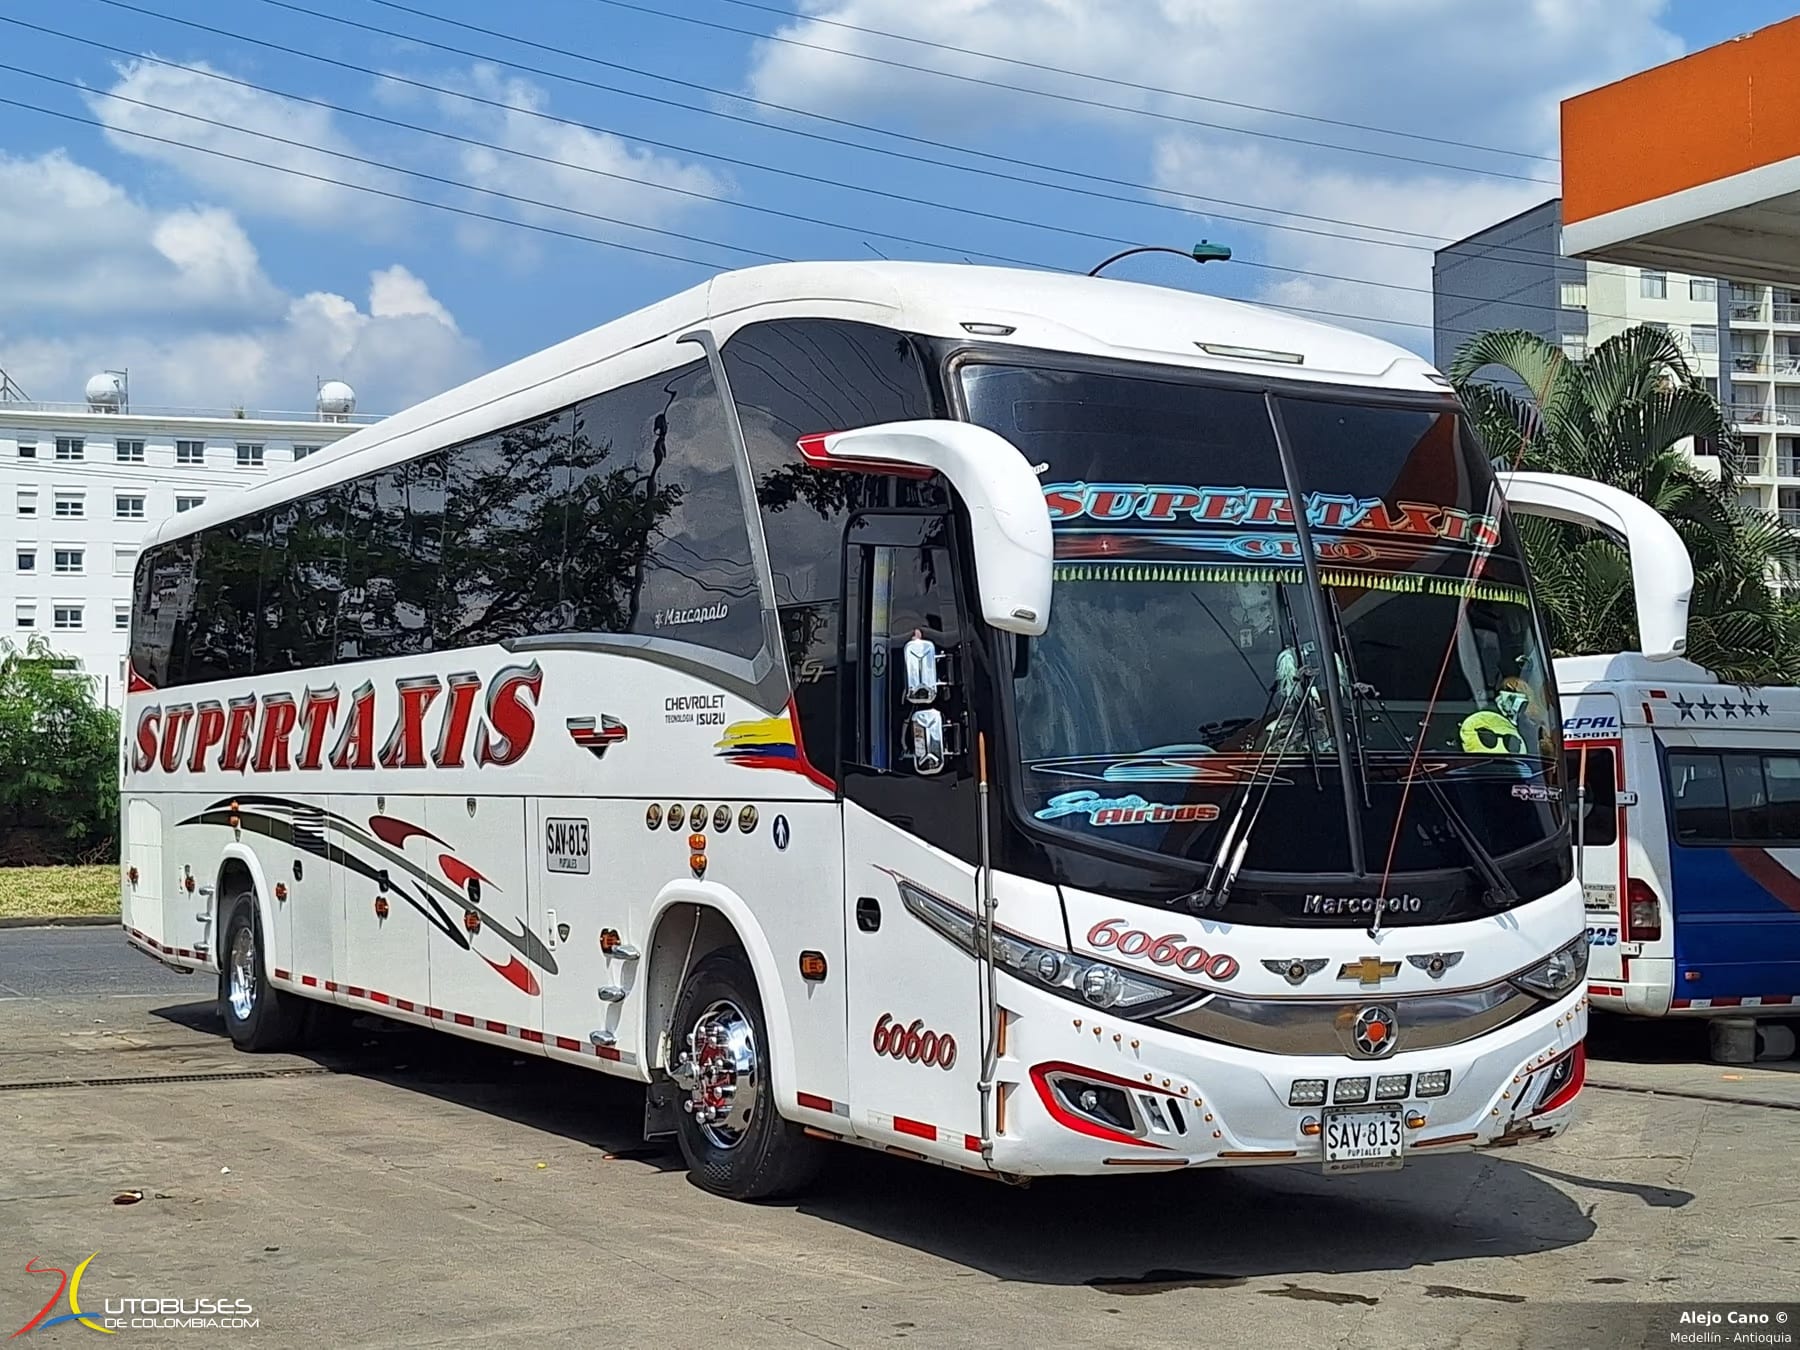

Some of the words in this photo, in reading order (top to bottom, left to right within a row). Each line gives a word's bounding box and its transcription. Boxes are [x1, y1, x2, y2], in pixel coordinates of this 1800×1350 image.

[1042, 482, 1500, 546] SUPERTAXIS
[664, 602, 728, 626] Marcopolo
[665, 695, 725, 711] CHEVROLET
[132, 656, 544, 777] SUPERTAXIS
[665, 714, 694, 723] TECNOLOGIA
[696, 712, 725, 725] ISUZU
[1093, 803, 1220, 826] Airbus
[1303, 893, 1422, 914] Marcopolo
[1086, 918, 1240, 982] 60600
[873, 1012, 957, 1071] 60600
[1347, 1147, 1382, 1158] PUPIALES
